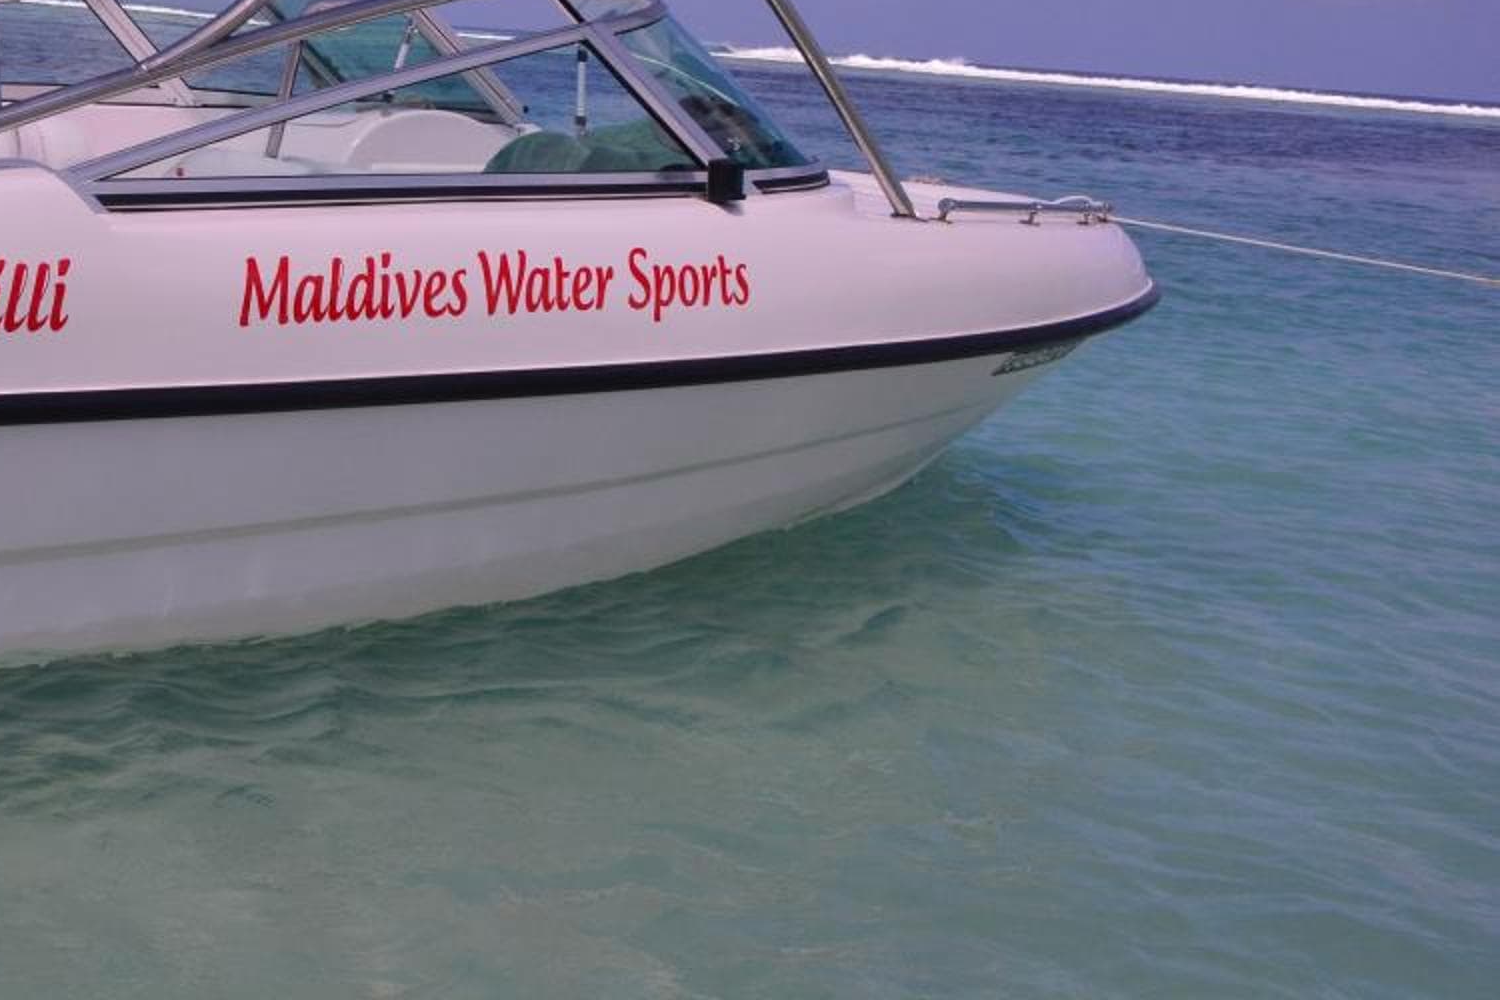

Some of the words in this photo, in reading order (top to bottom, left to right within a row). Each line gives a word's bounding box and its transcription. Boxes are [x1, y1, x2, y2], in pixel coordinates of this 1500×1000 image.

[238, 252, 469, 328] Maldives
[476, 248, 614, 315] Water
[626, 246, 750, 322] Sports
